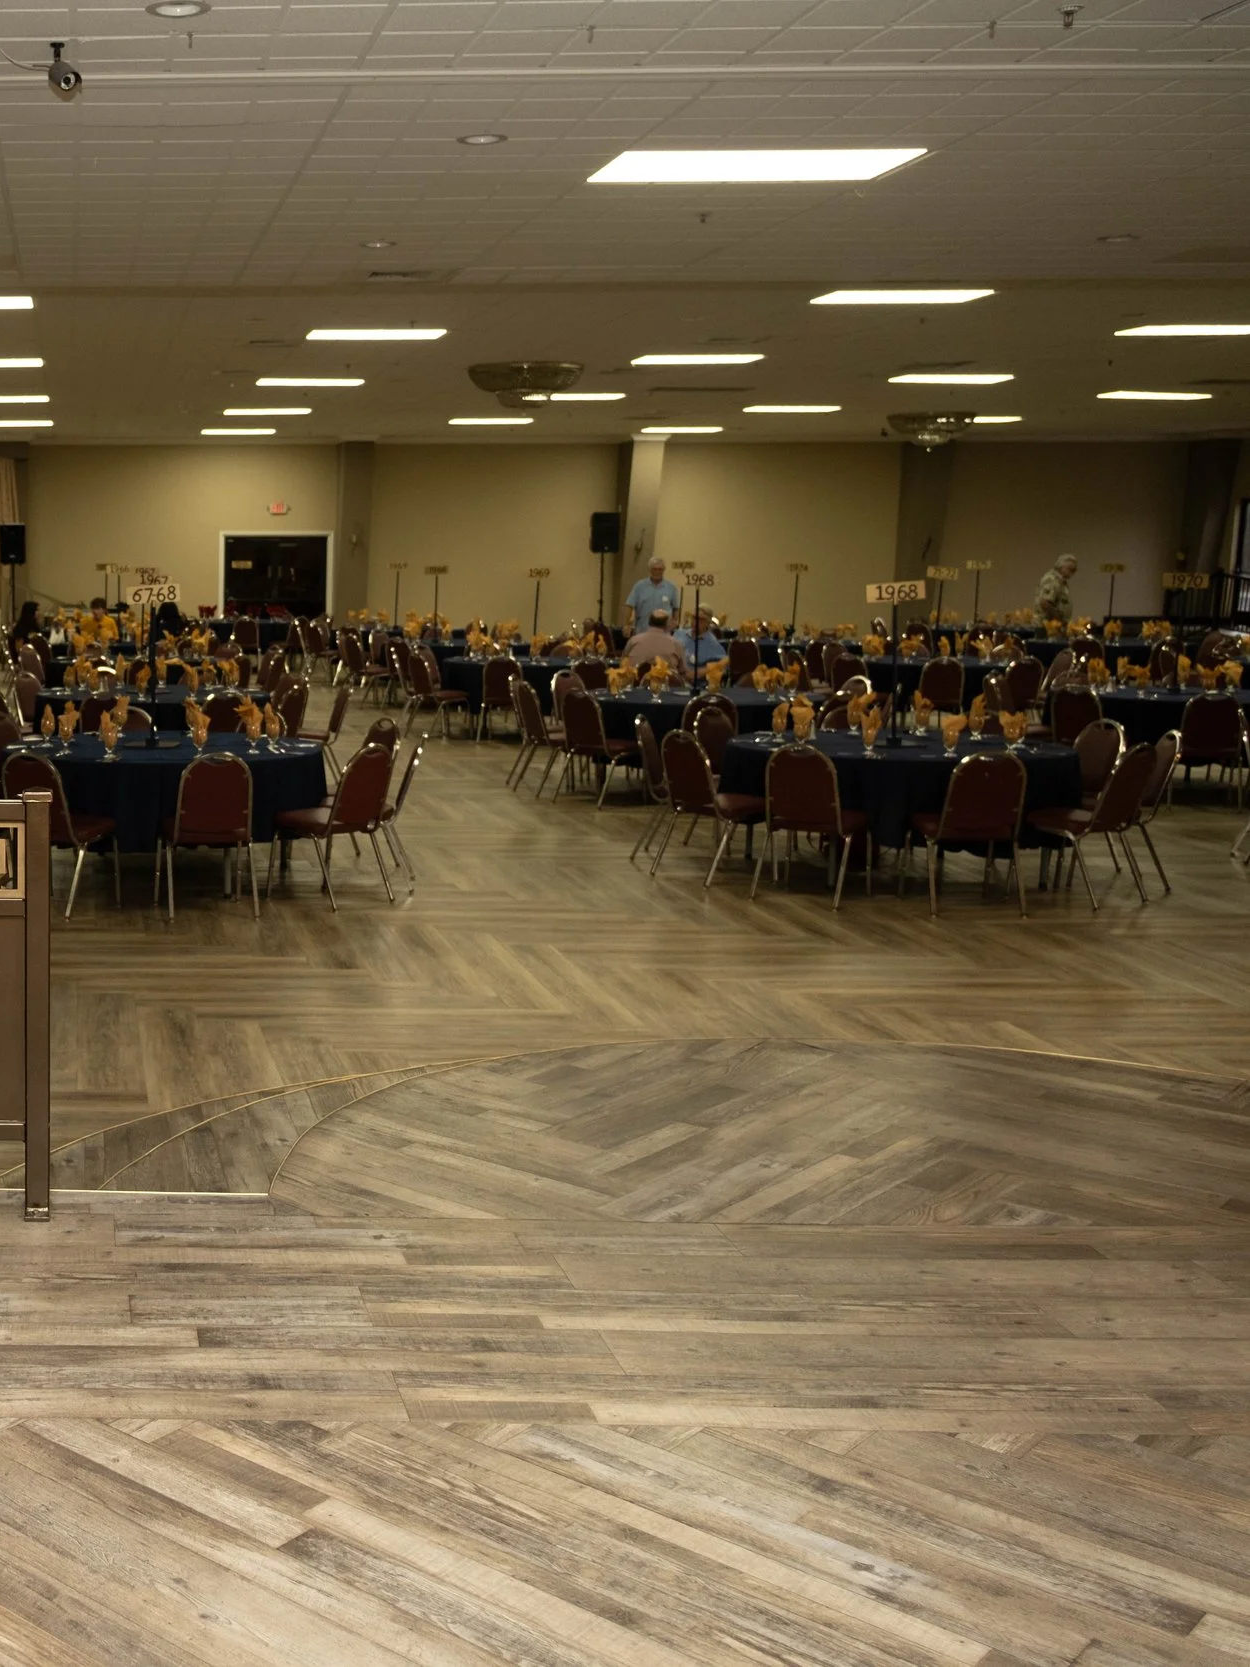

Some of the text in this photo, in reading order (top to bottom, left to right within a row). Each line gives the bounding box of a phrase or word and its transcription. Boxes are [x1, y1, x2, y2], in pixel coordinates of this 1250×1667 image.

[529, 567, 550, 578] 1969
[140, 574, 168, 585] 1967
[685, 573, 714, 587] 1968
[1172, 575, 1203, 587] 1970
[132, 585, 176, 603] 67-68
[875, 584, 918, 600] 1968
